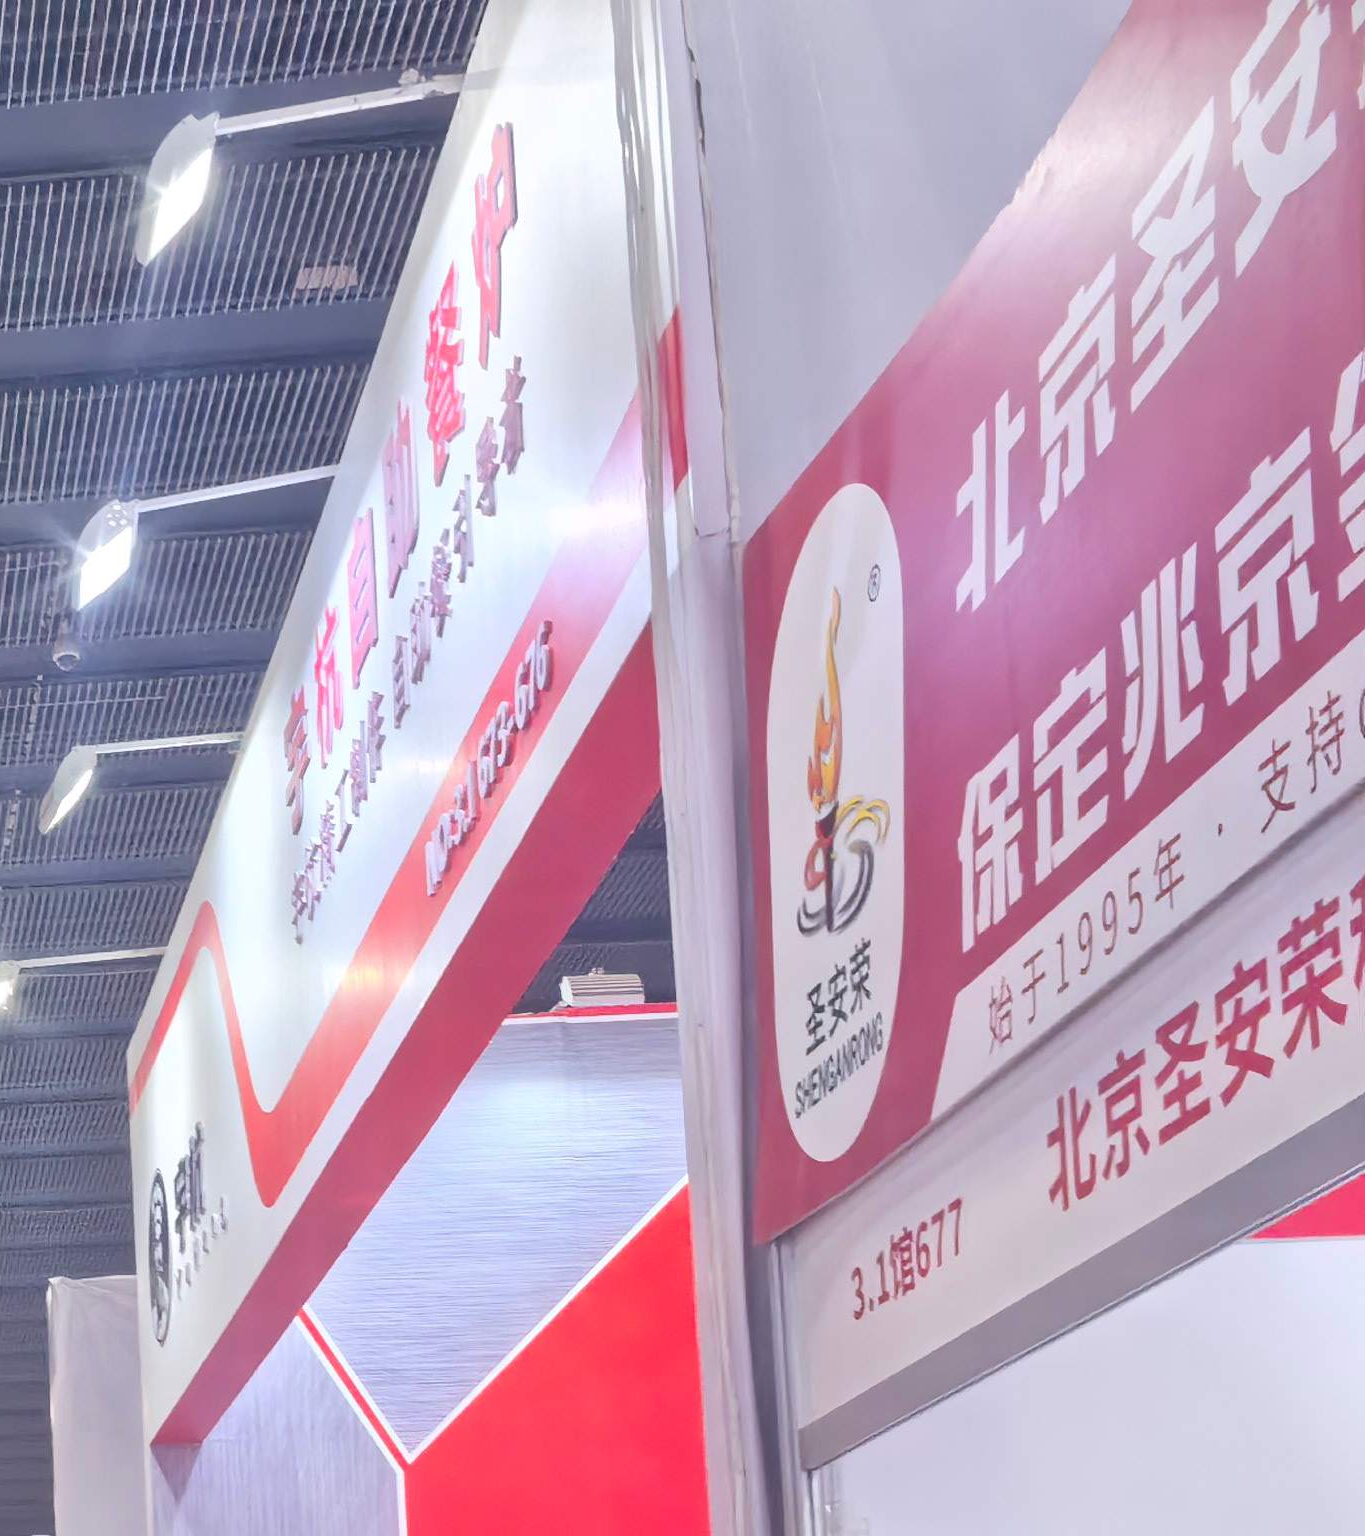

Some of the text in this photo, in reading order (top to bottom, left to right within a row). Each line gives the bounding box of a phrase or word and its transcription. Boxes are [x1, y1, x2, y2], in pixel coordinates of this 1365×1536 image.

[956, 0, 1365, 613] 北京圣安
[1258, 688, 1365, 833] 支持
[805, 937, 872, 1057] 圣安荣
[795, 1010, 884, 1120] SHENGANRONG
[851, 1197, 964, 1322] 3.1馆677
